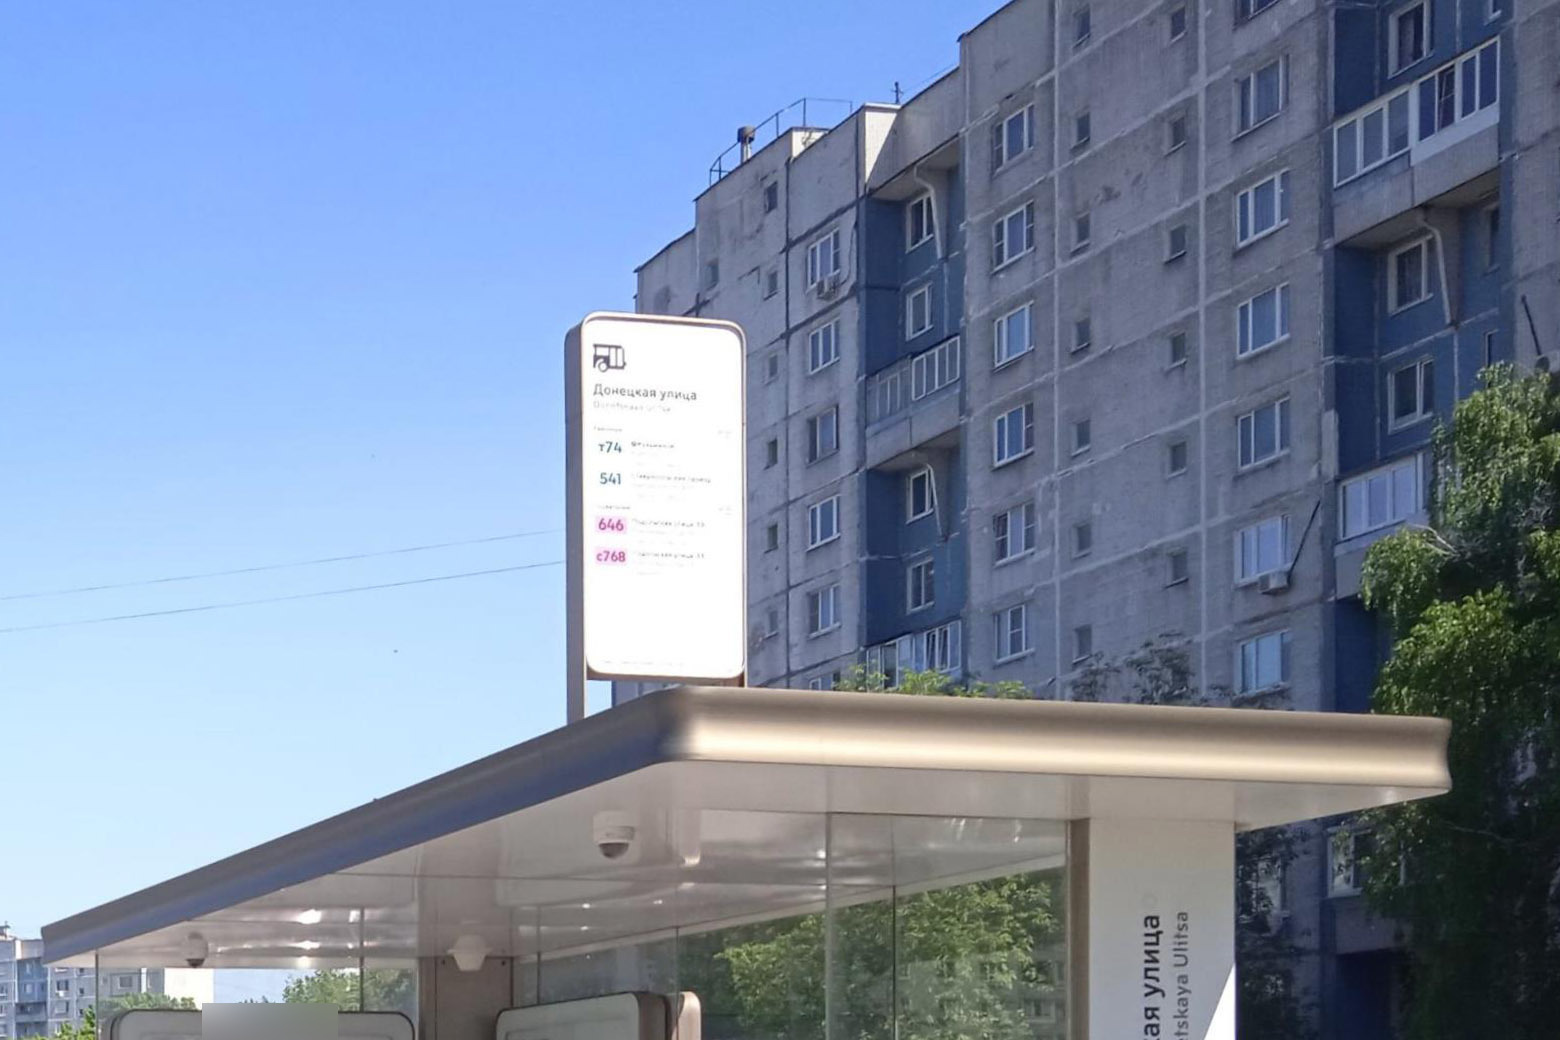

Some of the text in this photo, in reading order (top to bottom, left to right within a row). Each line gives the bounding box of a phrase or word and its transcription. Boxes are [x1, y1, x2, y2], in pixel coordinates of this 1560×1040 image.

[593, 383, 698, 401] Донецкая улица
[599, 472, 622, 485] 541
[598, 518, 624, 531] 646
[1173, 912, 1189, 967] Ulitsa
[1144, 915, 1166, 998] улица
